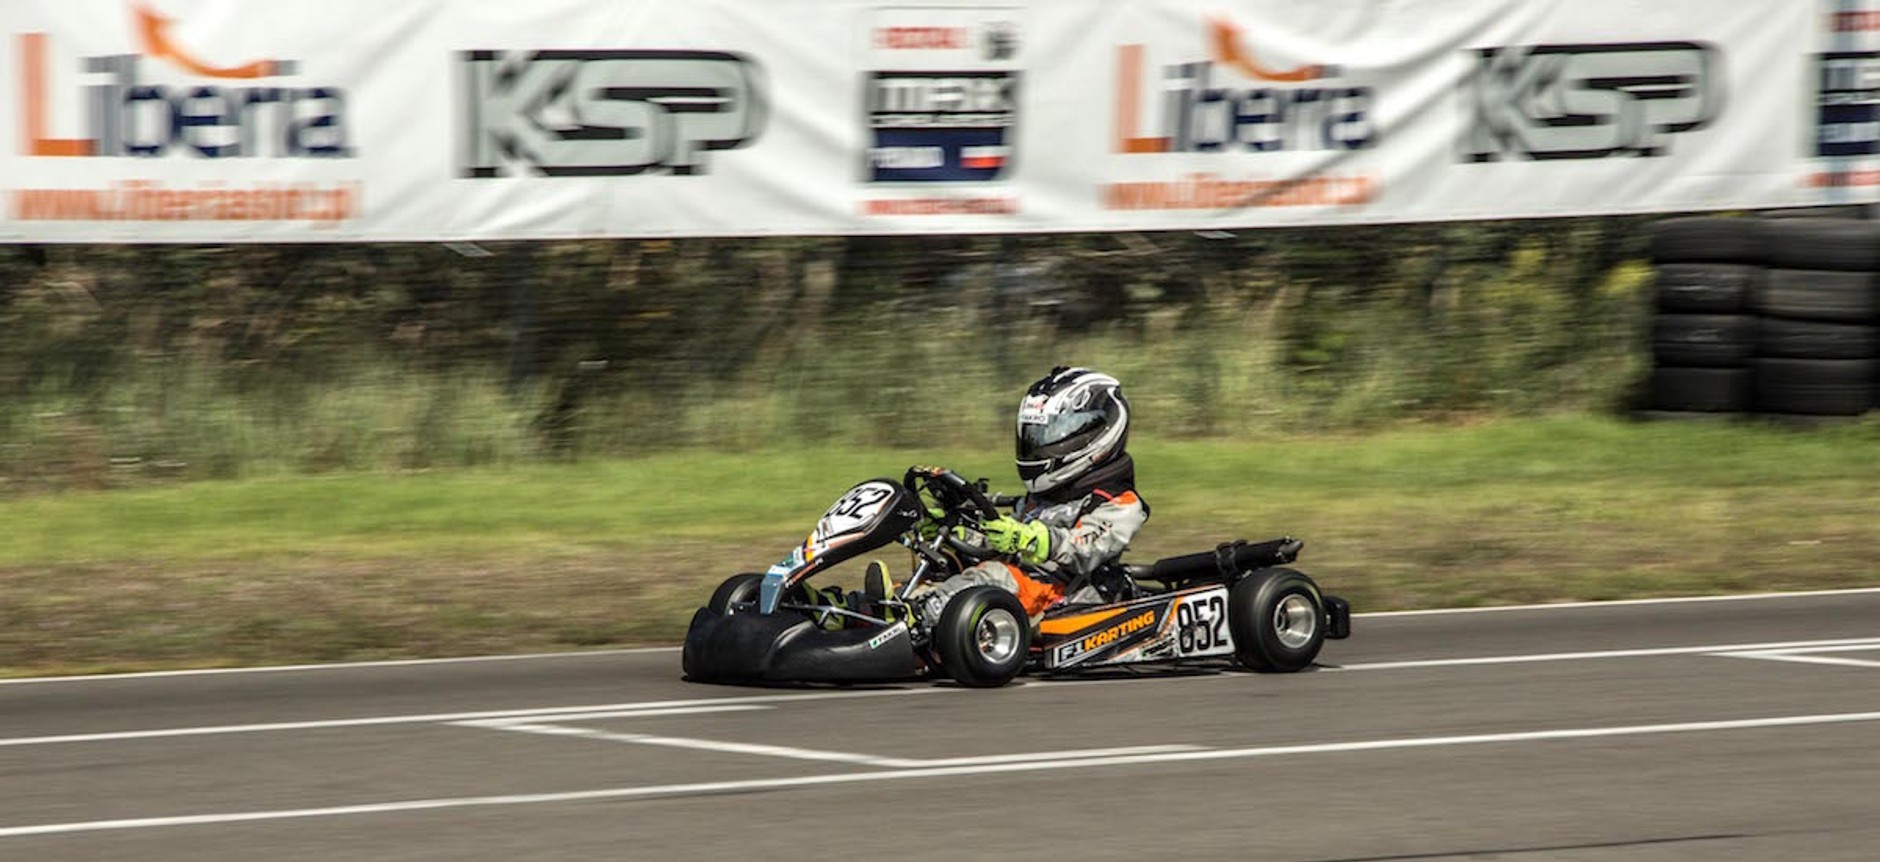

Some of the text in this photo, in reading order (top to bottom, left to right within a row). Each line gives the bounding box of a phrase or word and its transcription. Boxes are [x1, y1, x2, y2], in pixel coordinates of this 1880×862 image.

[14, 33, 357, 157] Liberia
[454, 49, 769, 178] KSP
[1110, 44, 1374, 153] Liberia
[1460, 40, 1727, 163] KSP
[1084, 610, 1155, 652] KARTING
[1177, 596, 1228, 653] 852
